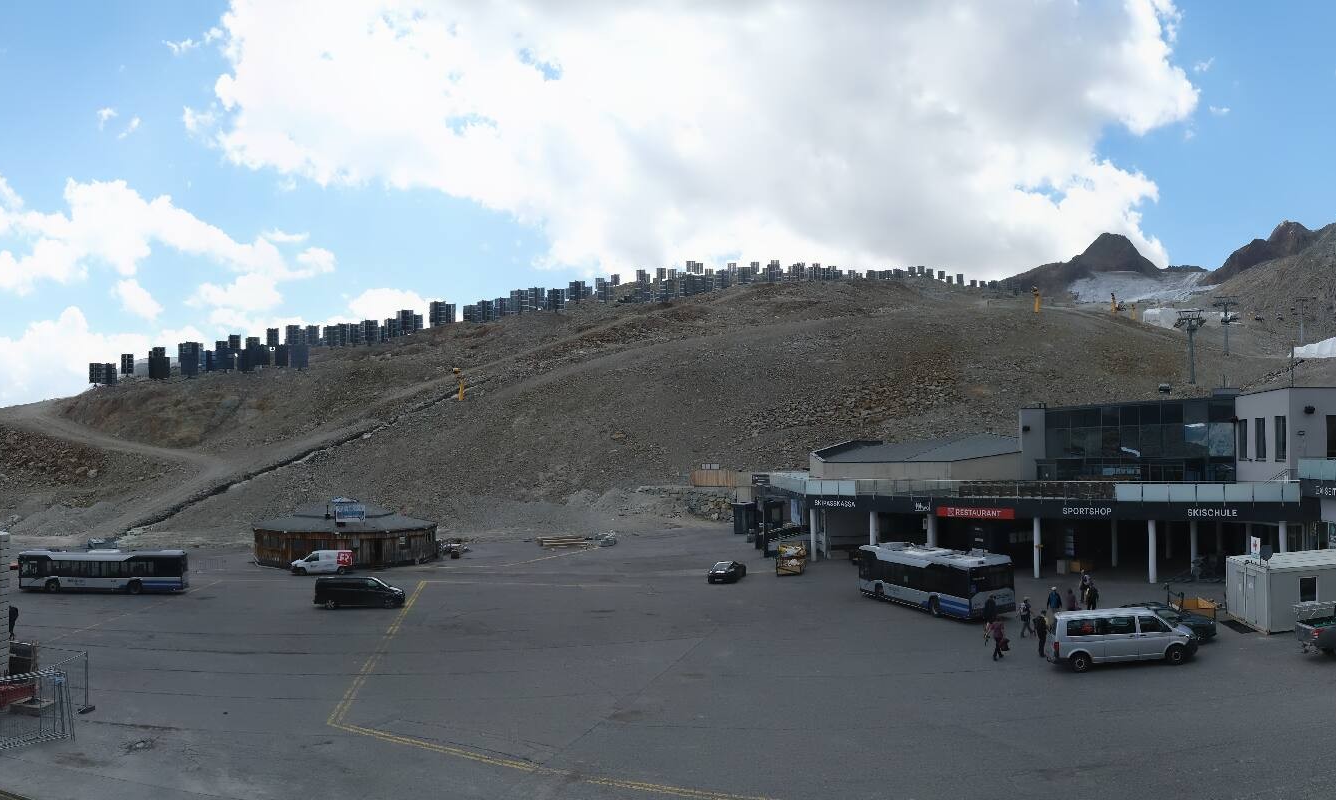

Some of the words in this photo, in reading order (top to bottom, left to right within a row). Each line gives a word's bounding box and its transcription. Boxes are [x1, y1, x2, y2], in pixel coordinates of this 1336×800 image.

[955, 508, 1002, 517] RESTAURANT
[1062, 507, 1112, 516] SPORTSHOP
[1187, 508, 1238, 517] SKISCHULE
